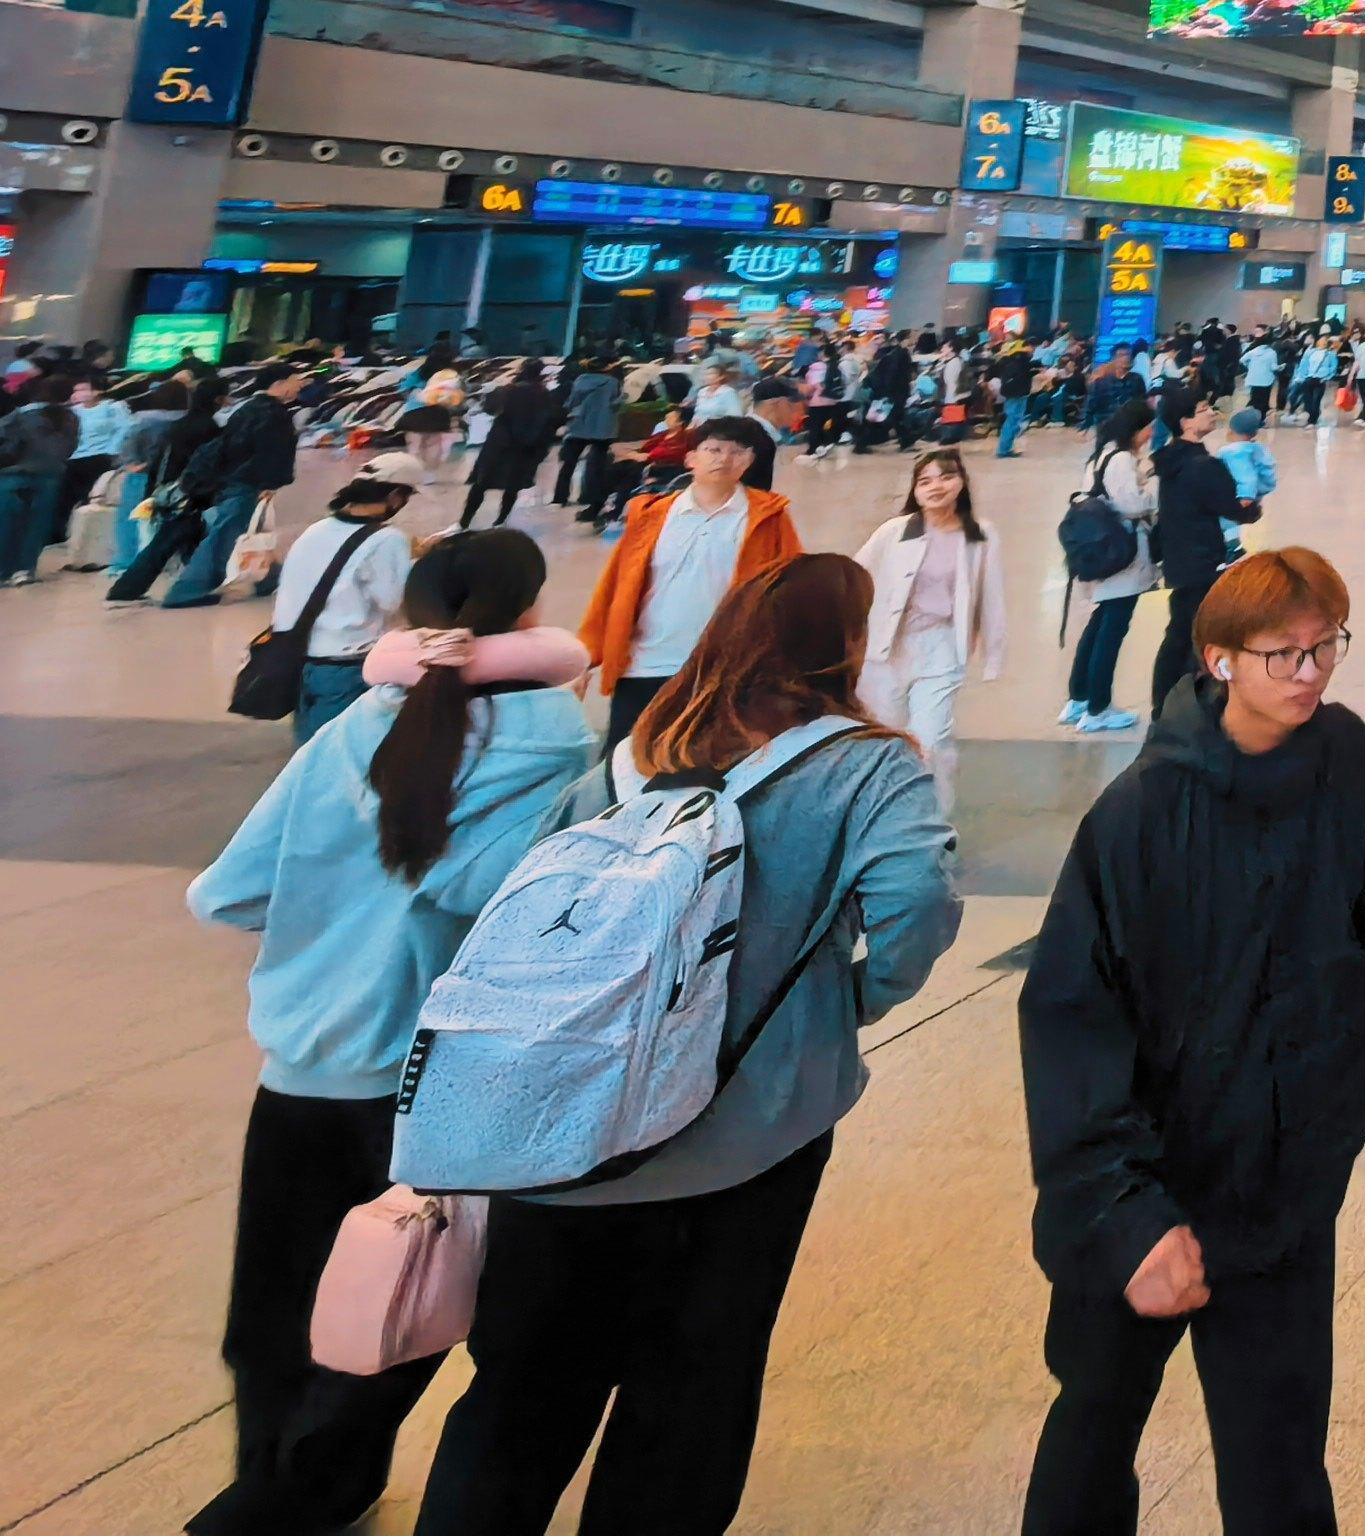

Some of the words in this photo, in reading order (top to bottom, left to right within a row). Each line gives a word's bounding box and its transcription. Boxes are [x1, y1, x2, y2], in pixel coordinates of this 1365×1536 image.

[154, 67, 213, 103] 5A
[979, 112, 1010, 134] 6A
[974, 156, 1006, 179] 7A
[1335, 163, 1357, 181] 8A
[482, 184, 521, 211] 6A
[1333, 197, 1354, 214] 9A
[773, 202, 805, 225] 7A
[1113, 240, 1152, 262] 4A
[1110, 270, 1149, 292] 5A
